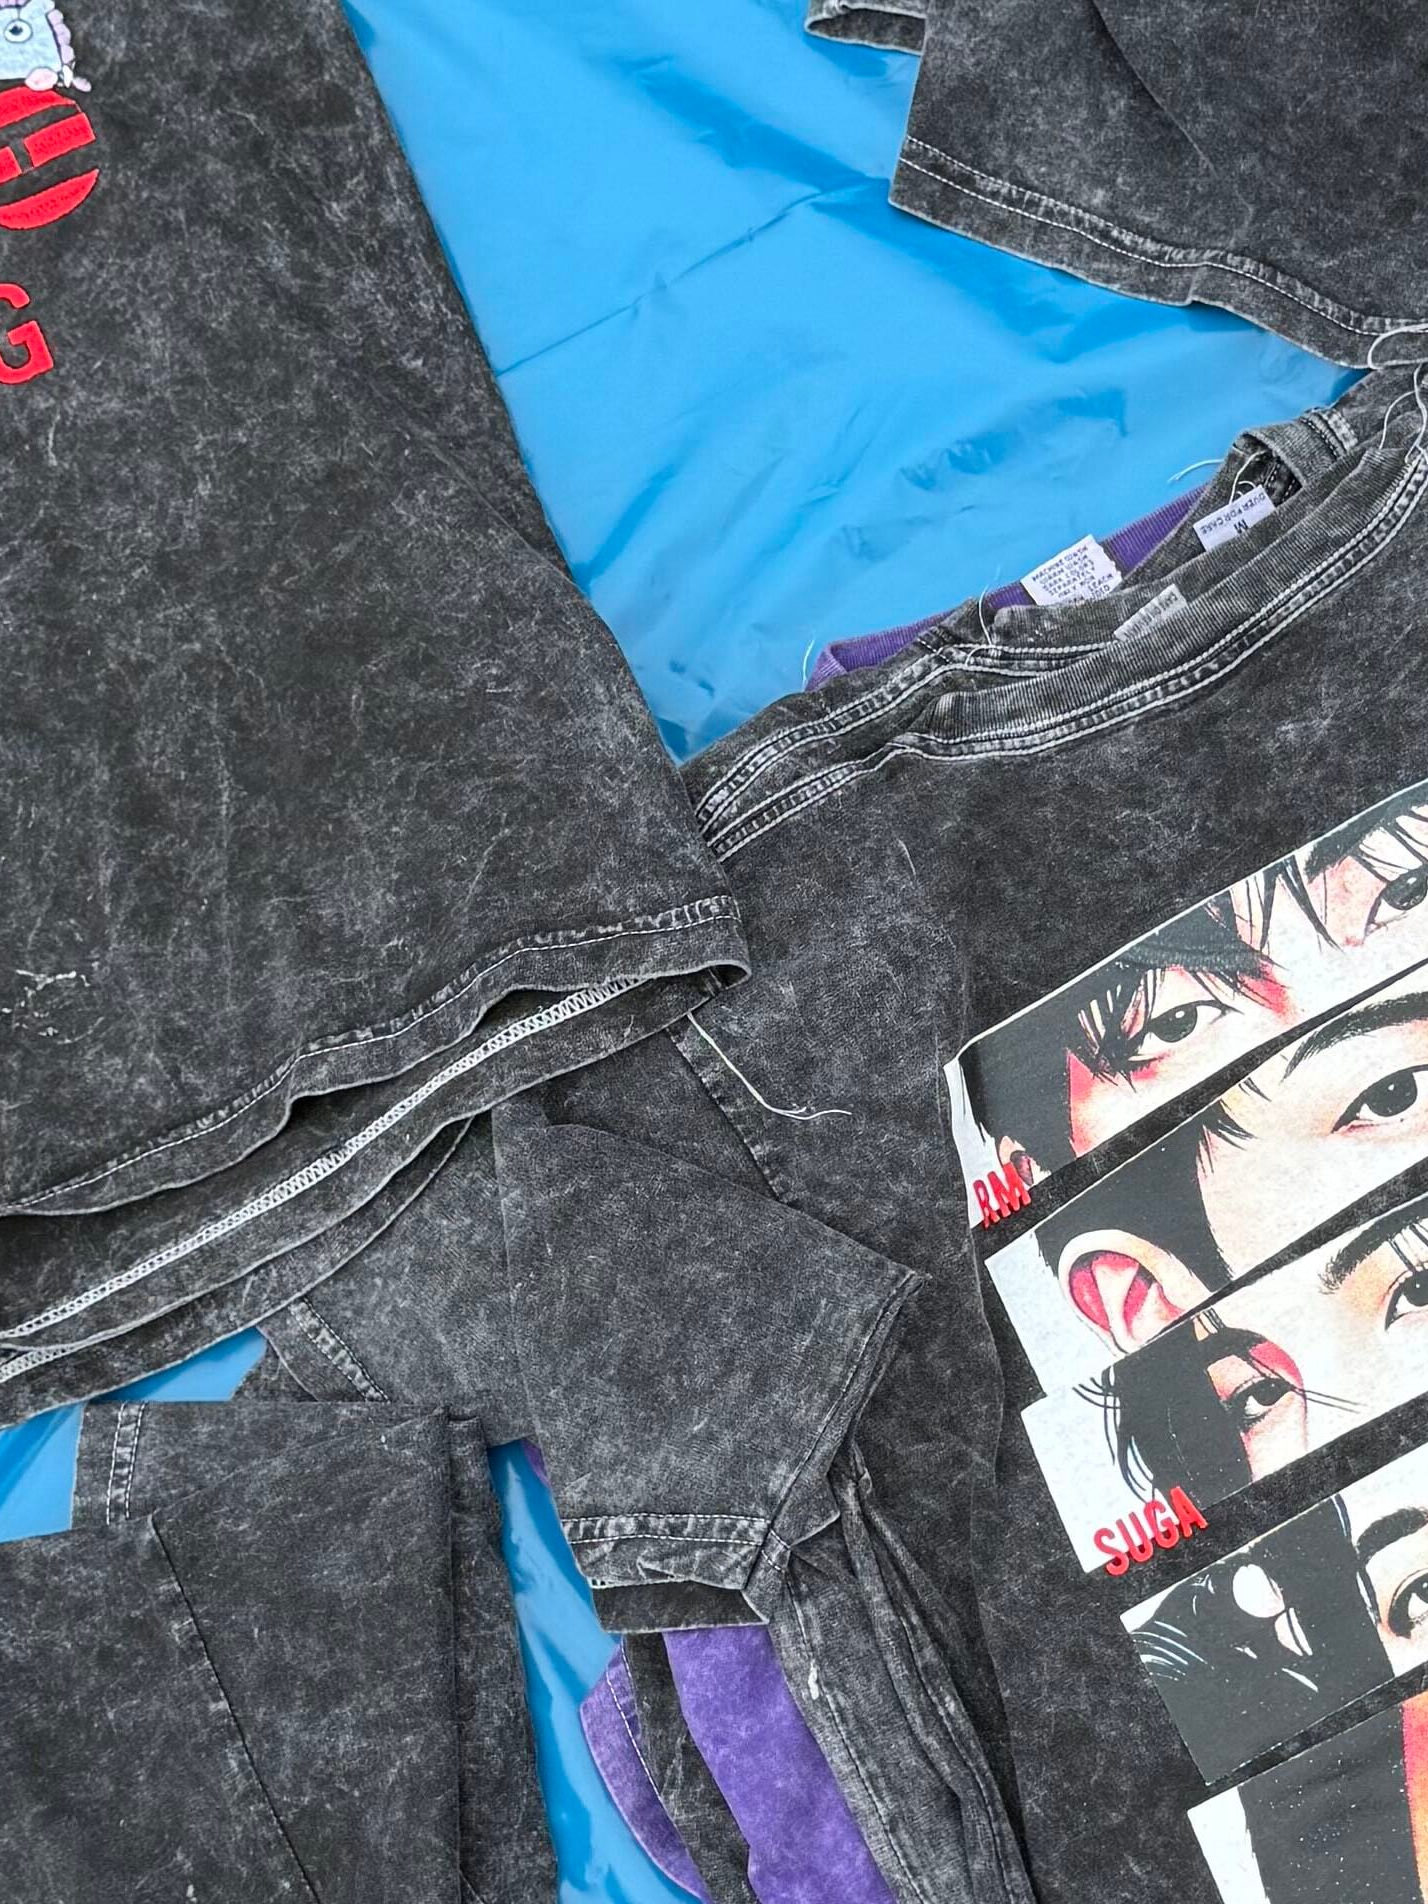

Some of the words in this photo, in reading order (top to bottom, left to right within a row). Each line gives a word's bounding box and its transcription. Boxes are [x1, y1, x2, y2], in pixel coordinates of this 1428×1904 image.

[1232, 517, 1249, 535] M
[972, 1161, 1032, 1229] RM
[1093, 1485, 1209, 1577] SUGA
